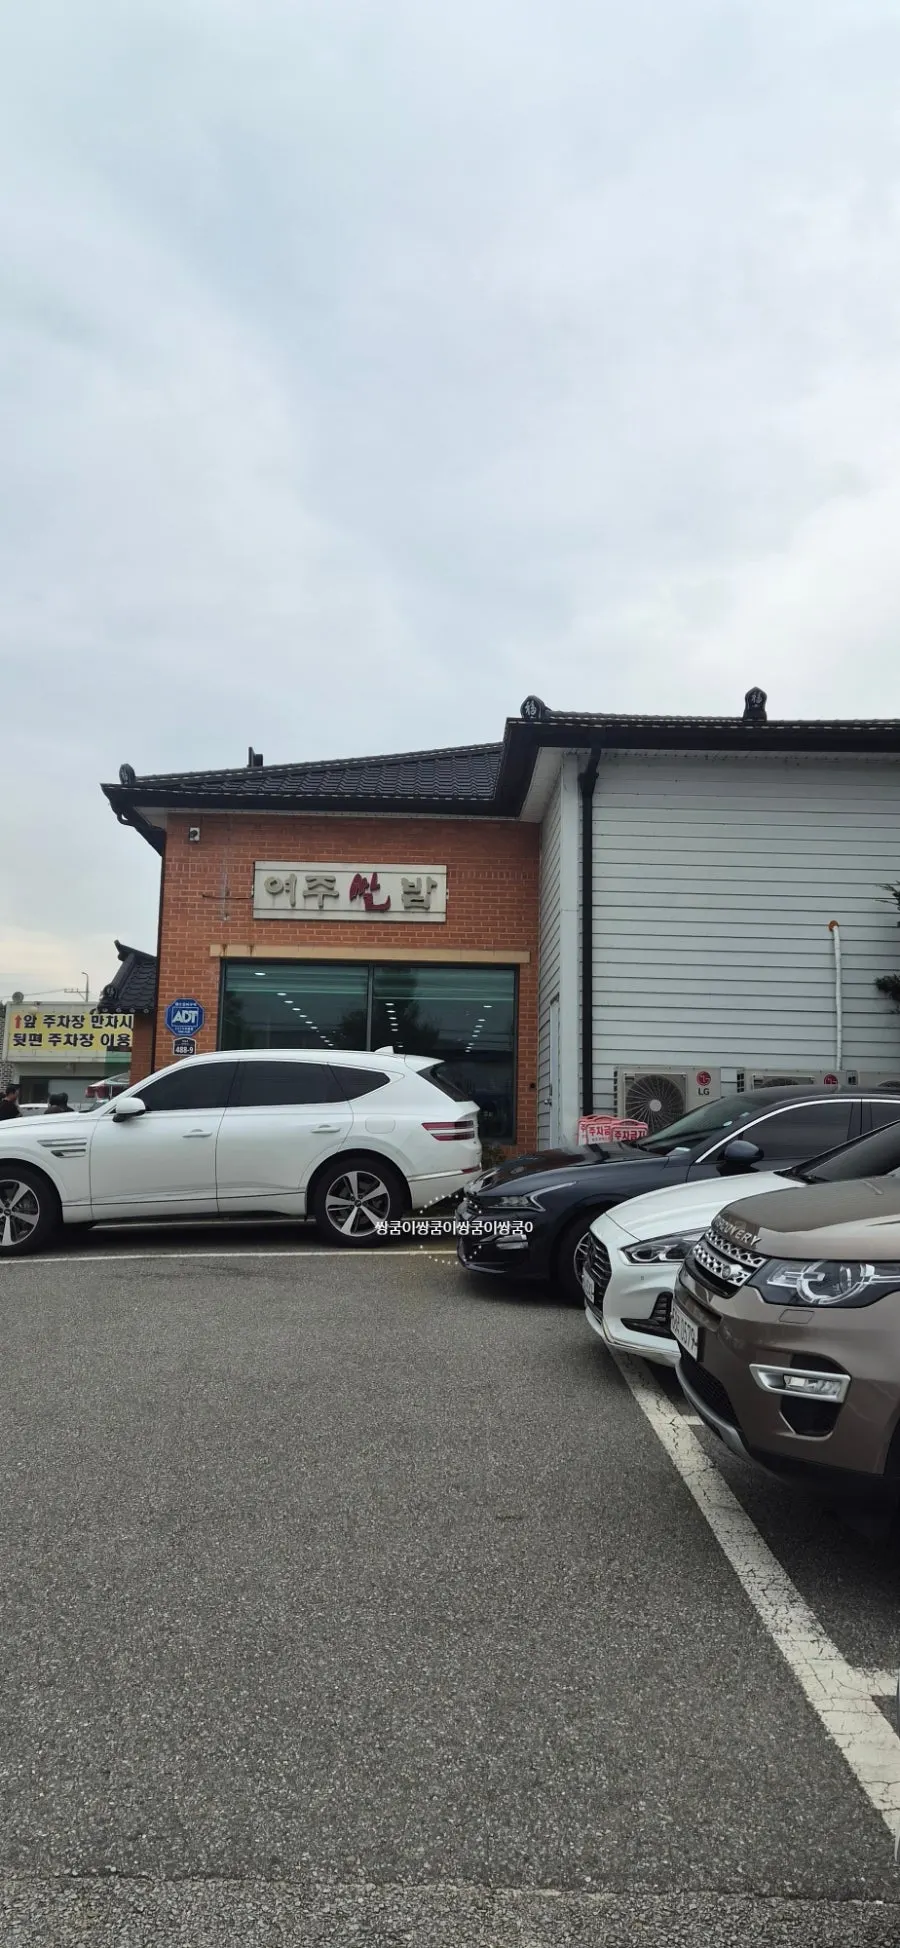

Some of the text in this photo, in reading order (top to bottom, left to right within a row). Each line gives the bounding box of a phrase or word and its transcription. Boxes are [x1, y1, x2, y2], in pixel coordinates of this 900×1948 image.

[23, 1014, 134, 1029] 앞 주차장 만차시
[172, 1010, 199, 1024] ADT
[12, 1033, 131, 1048] 뒷편 주차장 이용
